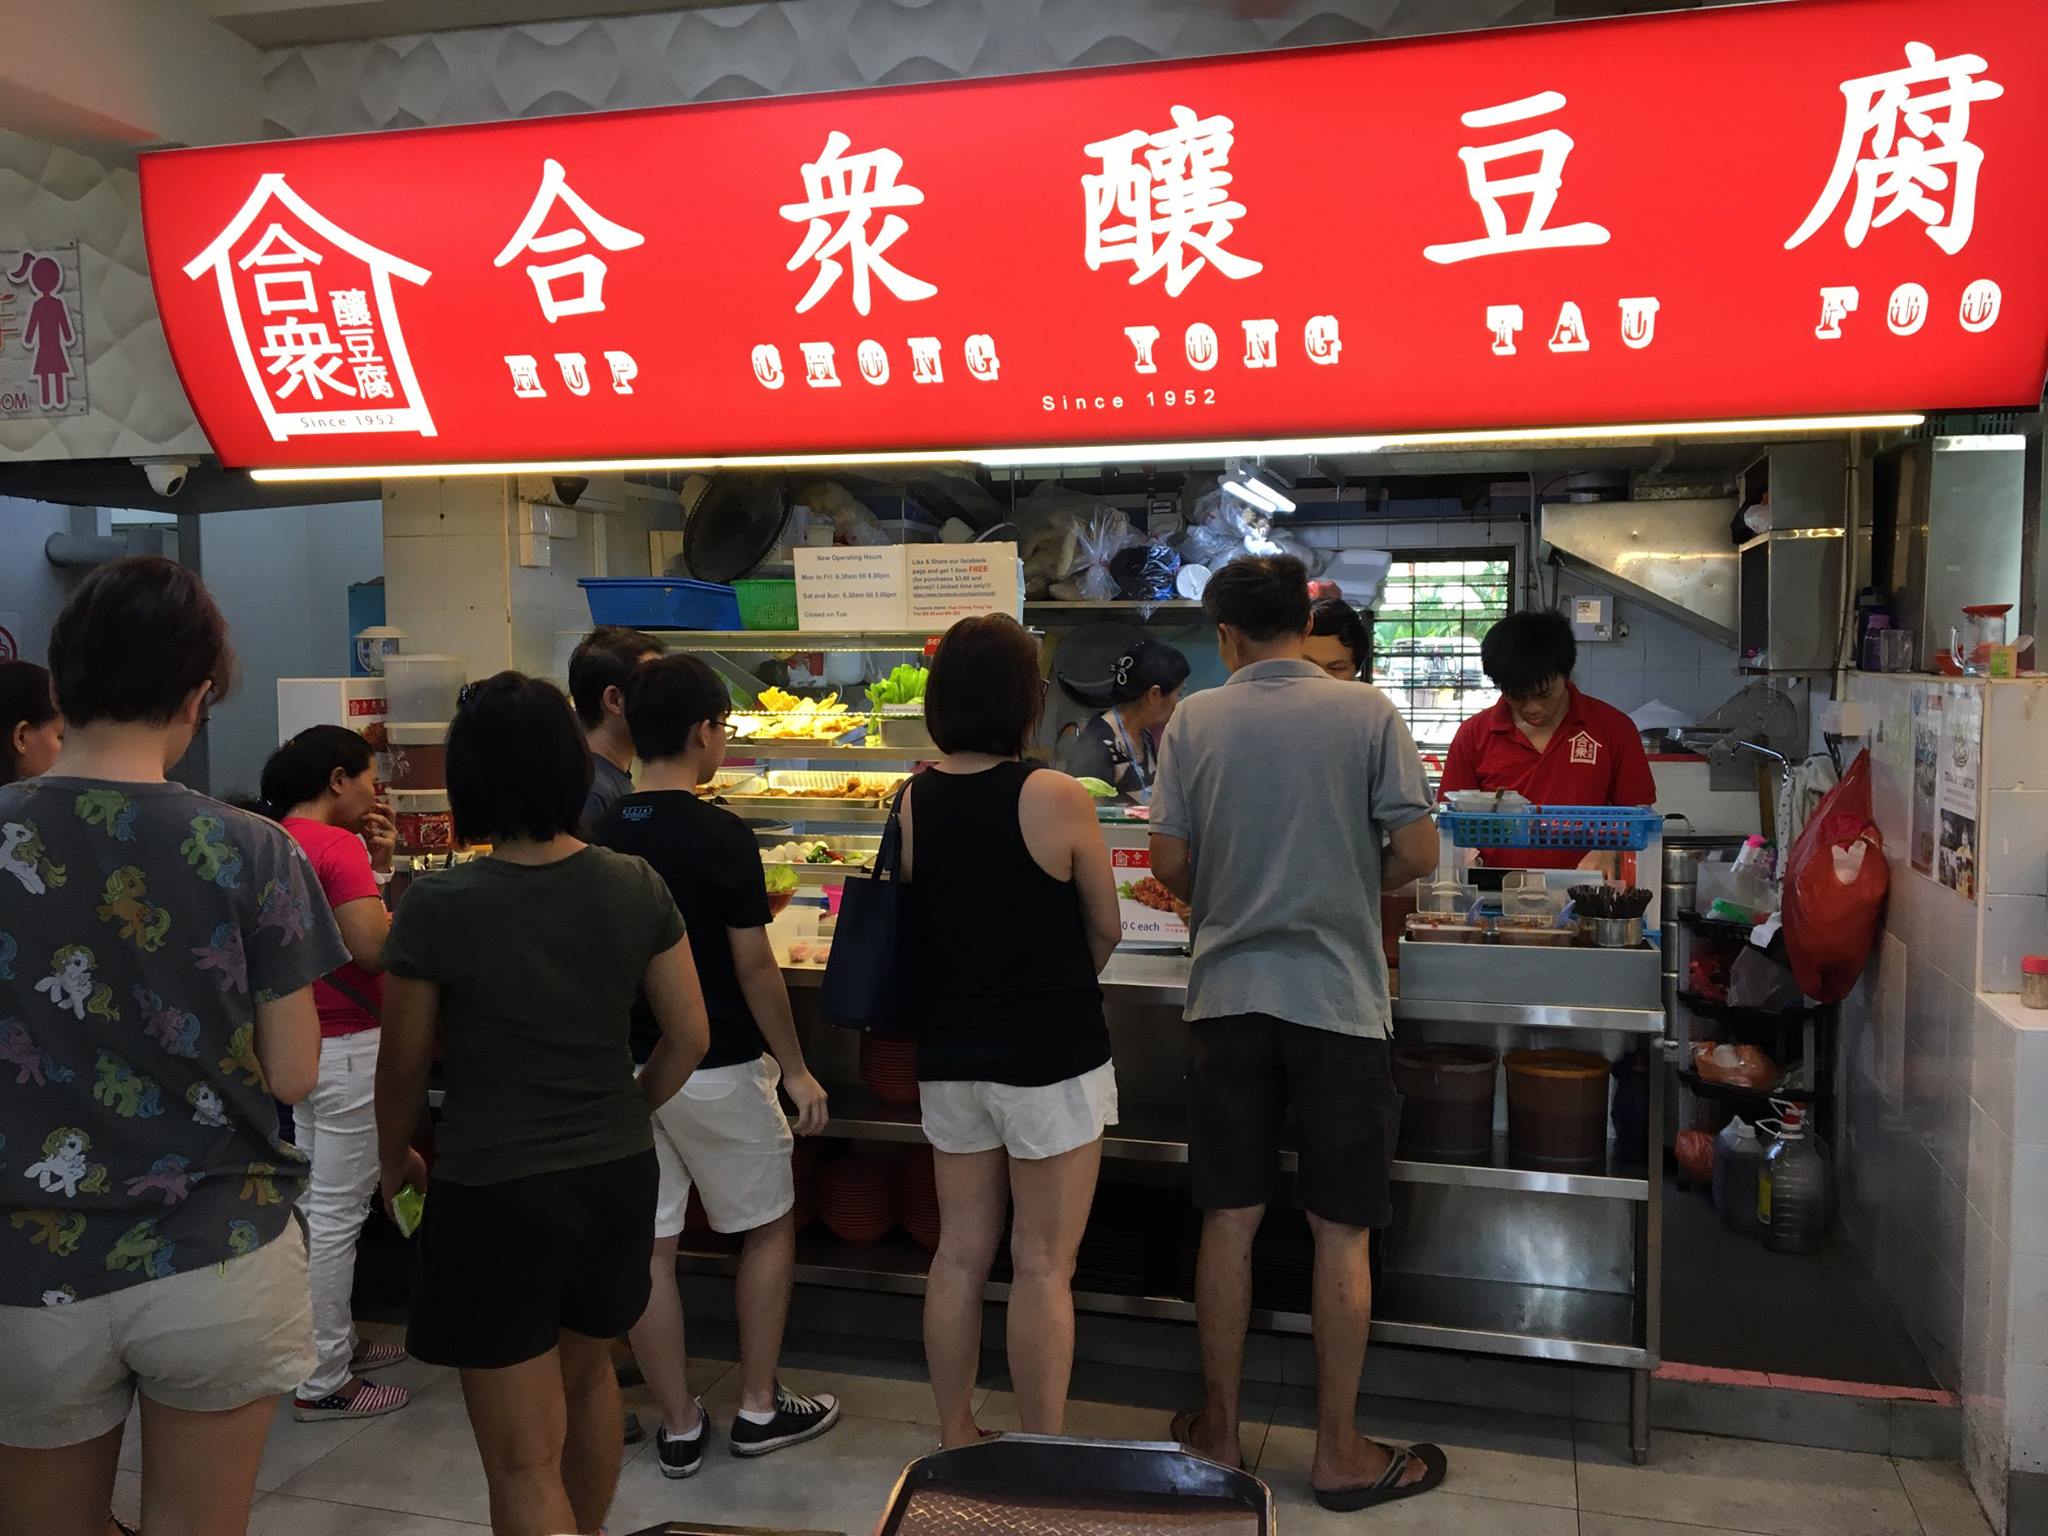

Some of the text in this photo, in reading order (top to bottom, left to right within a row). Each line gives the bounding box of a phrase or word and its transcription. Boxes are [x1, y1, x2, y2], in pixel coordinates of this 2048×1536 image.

[504, 279, 2001, 398] HUP CHONG YONG TAU FOO
[0, 392, 29, 411] OM
[1043, 389, 1215, 410] Since 1952
[300, 414, 395, 428] Since 1952
[832, 554, 862, 562] Operating
[968, 565, 989, 573] FREE
[1137, 922, 1160, 931] each
